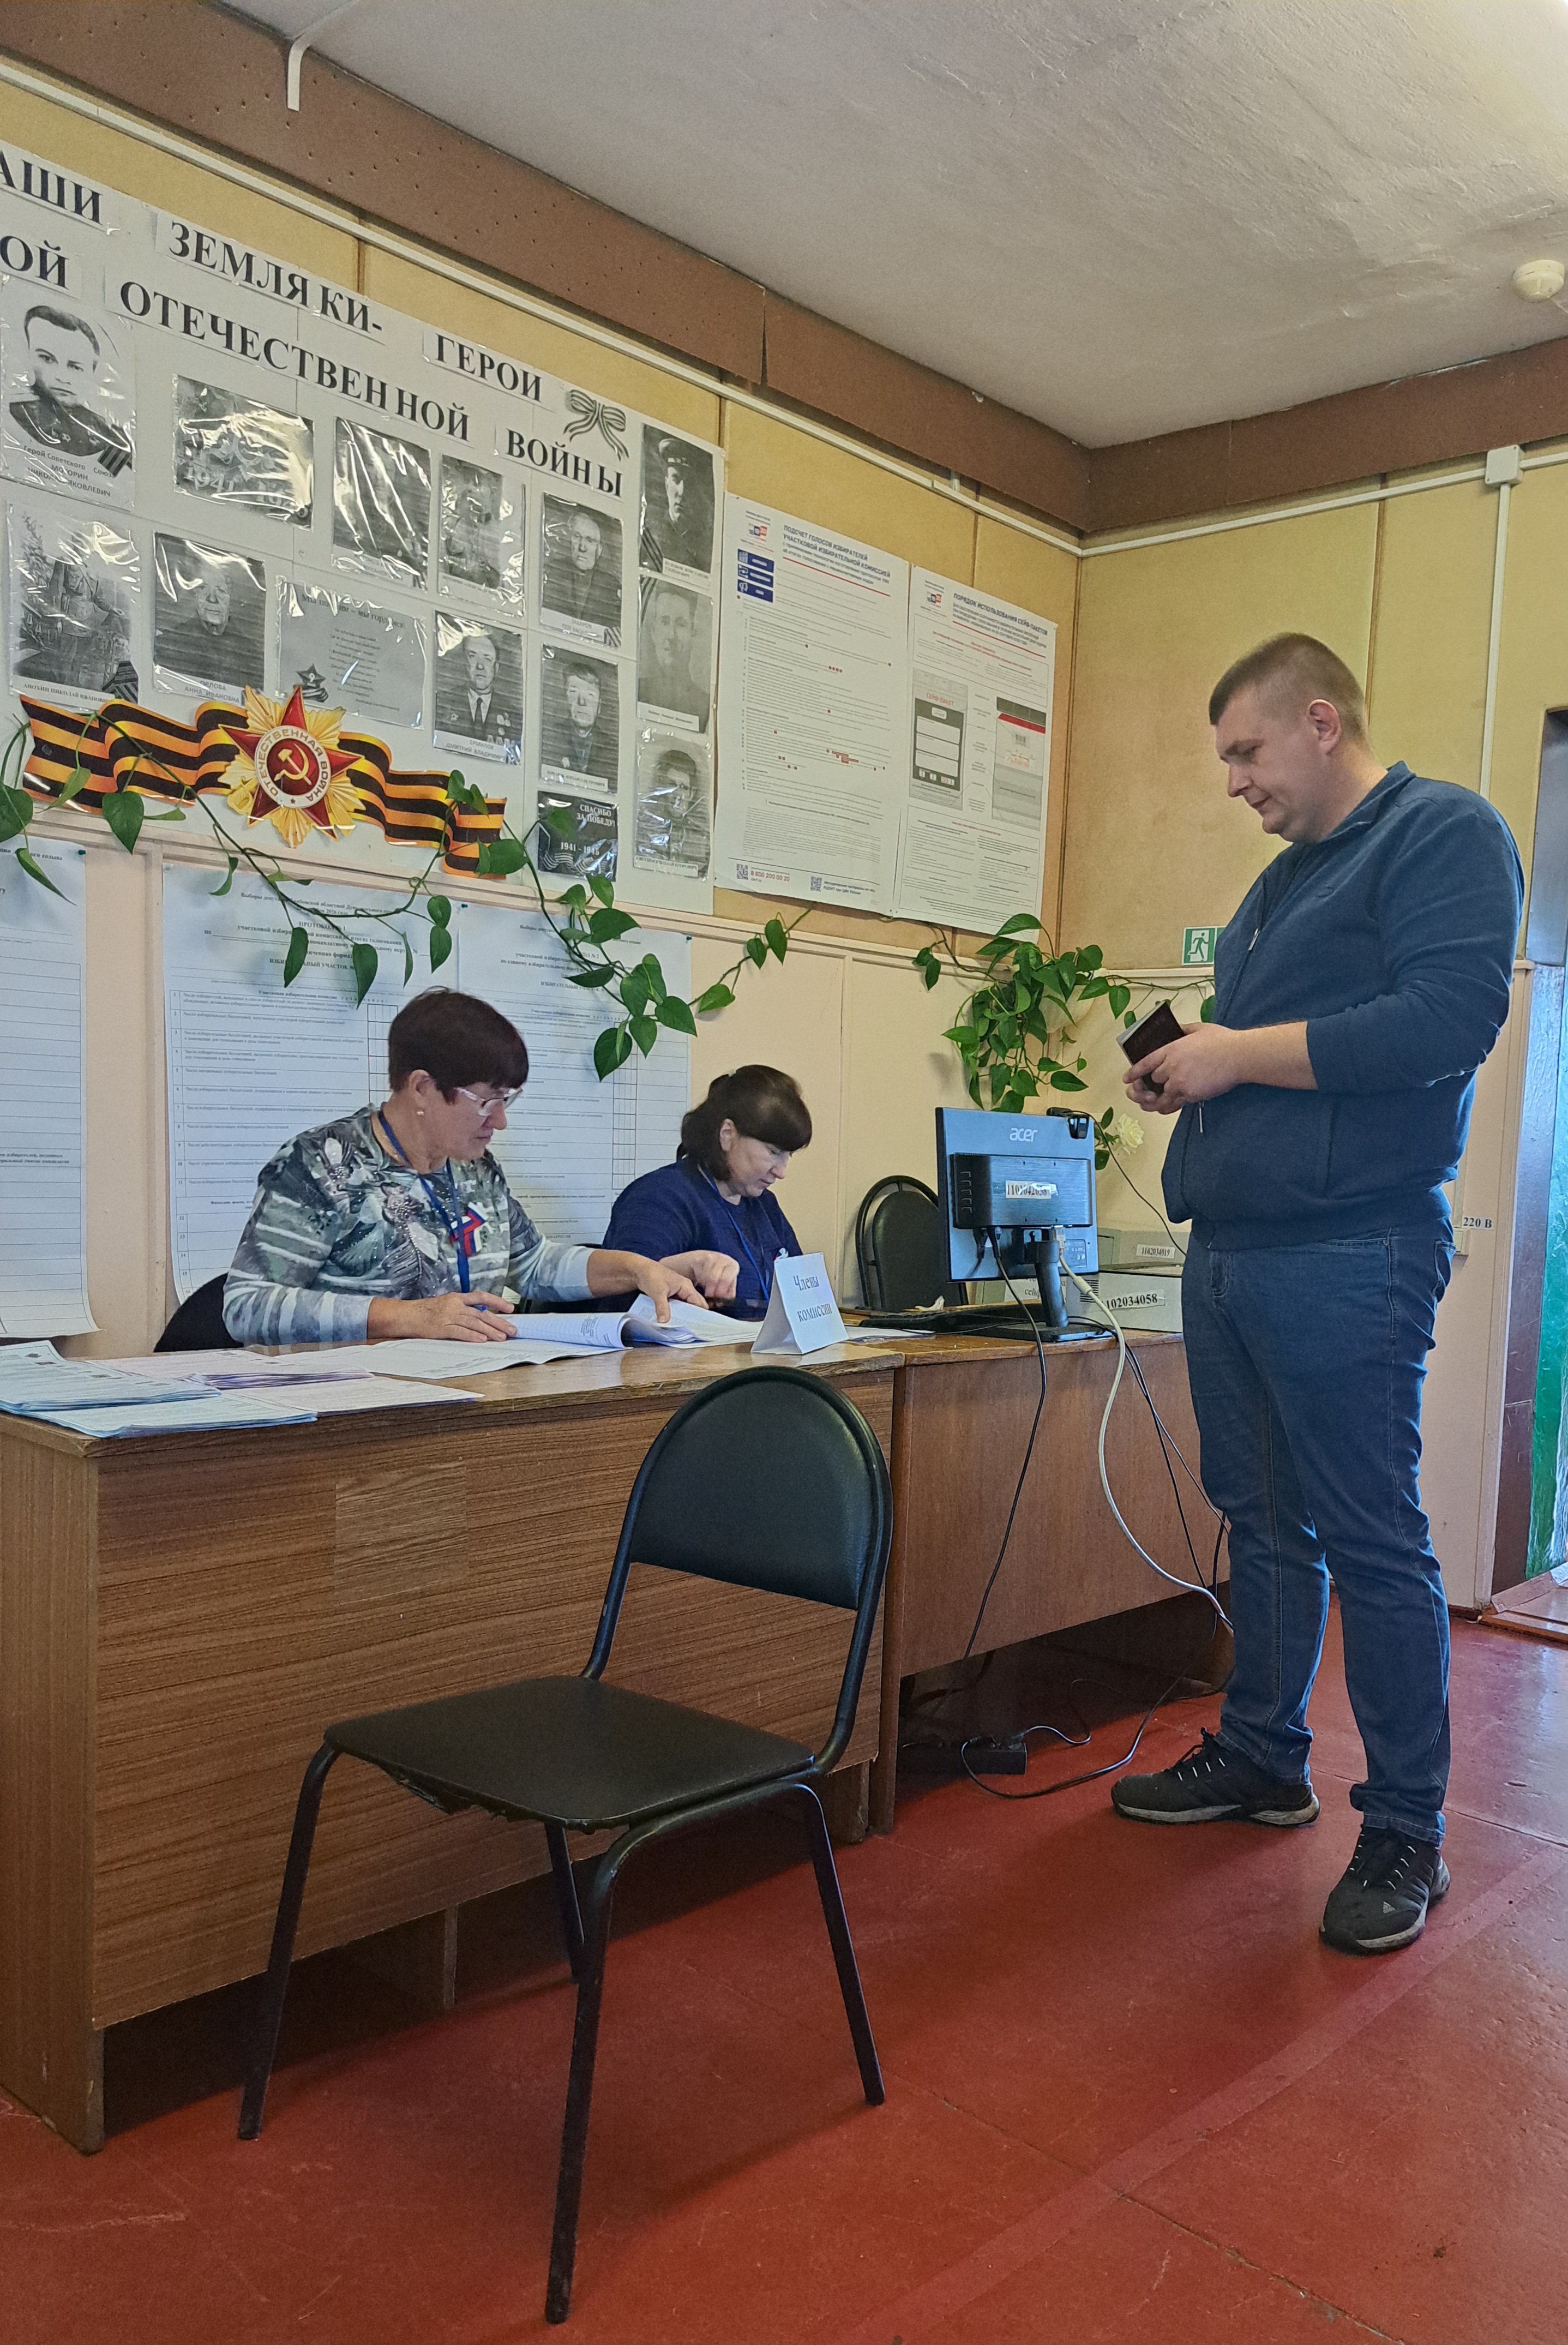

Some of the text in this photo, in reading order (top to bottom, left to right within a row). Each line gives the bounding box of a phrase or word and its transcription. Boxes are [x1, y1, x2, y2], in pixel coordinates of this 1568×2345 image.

[1, 235, 623, 497] ОЙ ОТЕЧЕСТВЕННОЙ ВОЙНЫ
[436, 334, 542, 403] ГЕРОИ
[23, 445, 115, 478] Герой Советского Союз
[68, 480, 111, 497] ЯКОВЛЕВИЧ
[783, 533, 818, 551] УЧАСТКОВОЙ
[818, 548, 860, 566] ИЗБИРАТЕЛЬНОЙ
[861, 562, 891, 578] КОМИССИЕЙ
[808, 535, 832, 548] ГОЛОСОВ
[833, 543, 868, 561] ИЗБИРАТЕЛЕЙ
[953, 593, 976, 607] ПОРЯДОК
[977, 602, 1017, 622] ИСПОЛЬЗОВАНИЯ
[200, 681, 226, 691] ОРЛОВА
[309, 673, 316, 683] 9
[23, 683, 50, 693] АНОХИН
[51, 688, 79, 699] НИКОЛАЙ
[184, 686, 240, 704] АННА ИВАНОВНА
[446, 742, 472, 753] ДМИТРИЙ
[470, 739, 494, 751] ЕРМИЛОВ
[258, 728, 328, 802] ОТЕЧЕСТВЕННАЯ ВОЙНА
[576, 812, 585, 820] ЗА
[580, 804, 611, 817] СПАСИБО
[561, 842, 576, 851] 1941
[584, 845, 600, 855] 1945
[321, 962, 349, 970] УЧАСТОК
[1010, 1127, 1038, 1142] acer
[1463, 1217, 1492, 1228] 220 В
[793, 1275, 820, 1292] Члены
[1102, 1292, 1157, 1310] 102034058
[797, 1303, 832, 1322] комиссии
